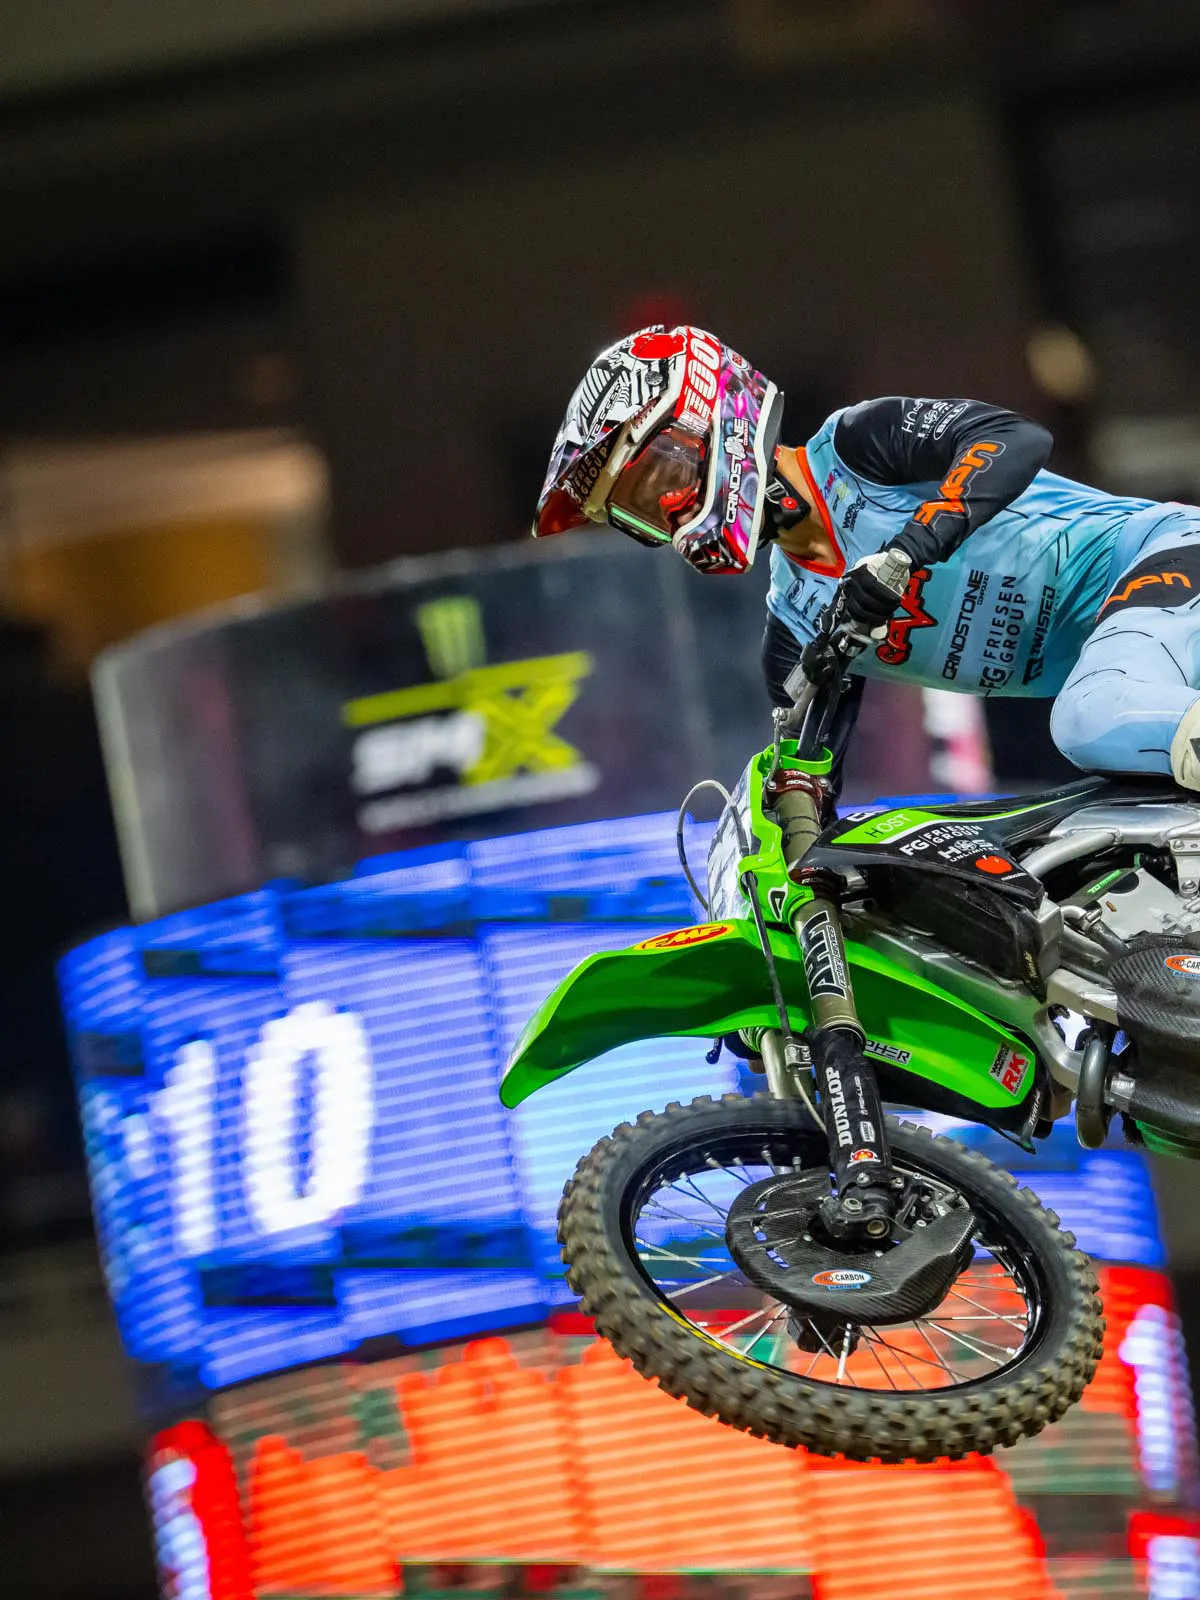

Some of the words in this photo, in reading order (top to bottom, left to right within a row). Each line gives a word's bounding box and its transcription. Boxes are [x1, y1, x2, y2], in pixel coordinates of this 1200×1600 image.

[580, 445, 608, 496] GROUP
[942, 569, 984, 679] GRINDSTONE
[983, 575, 1017, 659] FRIESEN
[999, 592, 1026, 662] GROUP
[1033, 584, 1055, 655] TWISTED
[864, 813, 912, 838] HOST
[899, 839, 930, 856] FG
[923, 825, 983, 840] FRIESEN
[931, 829, 980, 844] GROUP
[949, 846, 1000, 862] UNLIMITED
[865, 1039, 911, 1063] PHER
[1001, 1051, 1026, 1092] RK
[826, 1066, 853, 1147] DUNLOP
